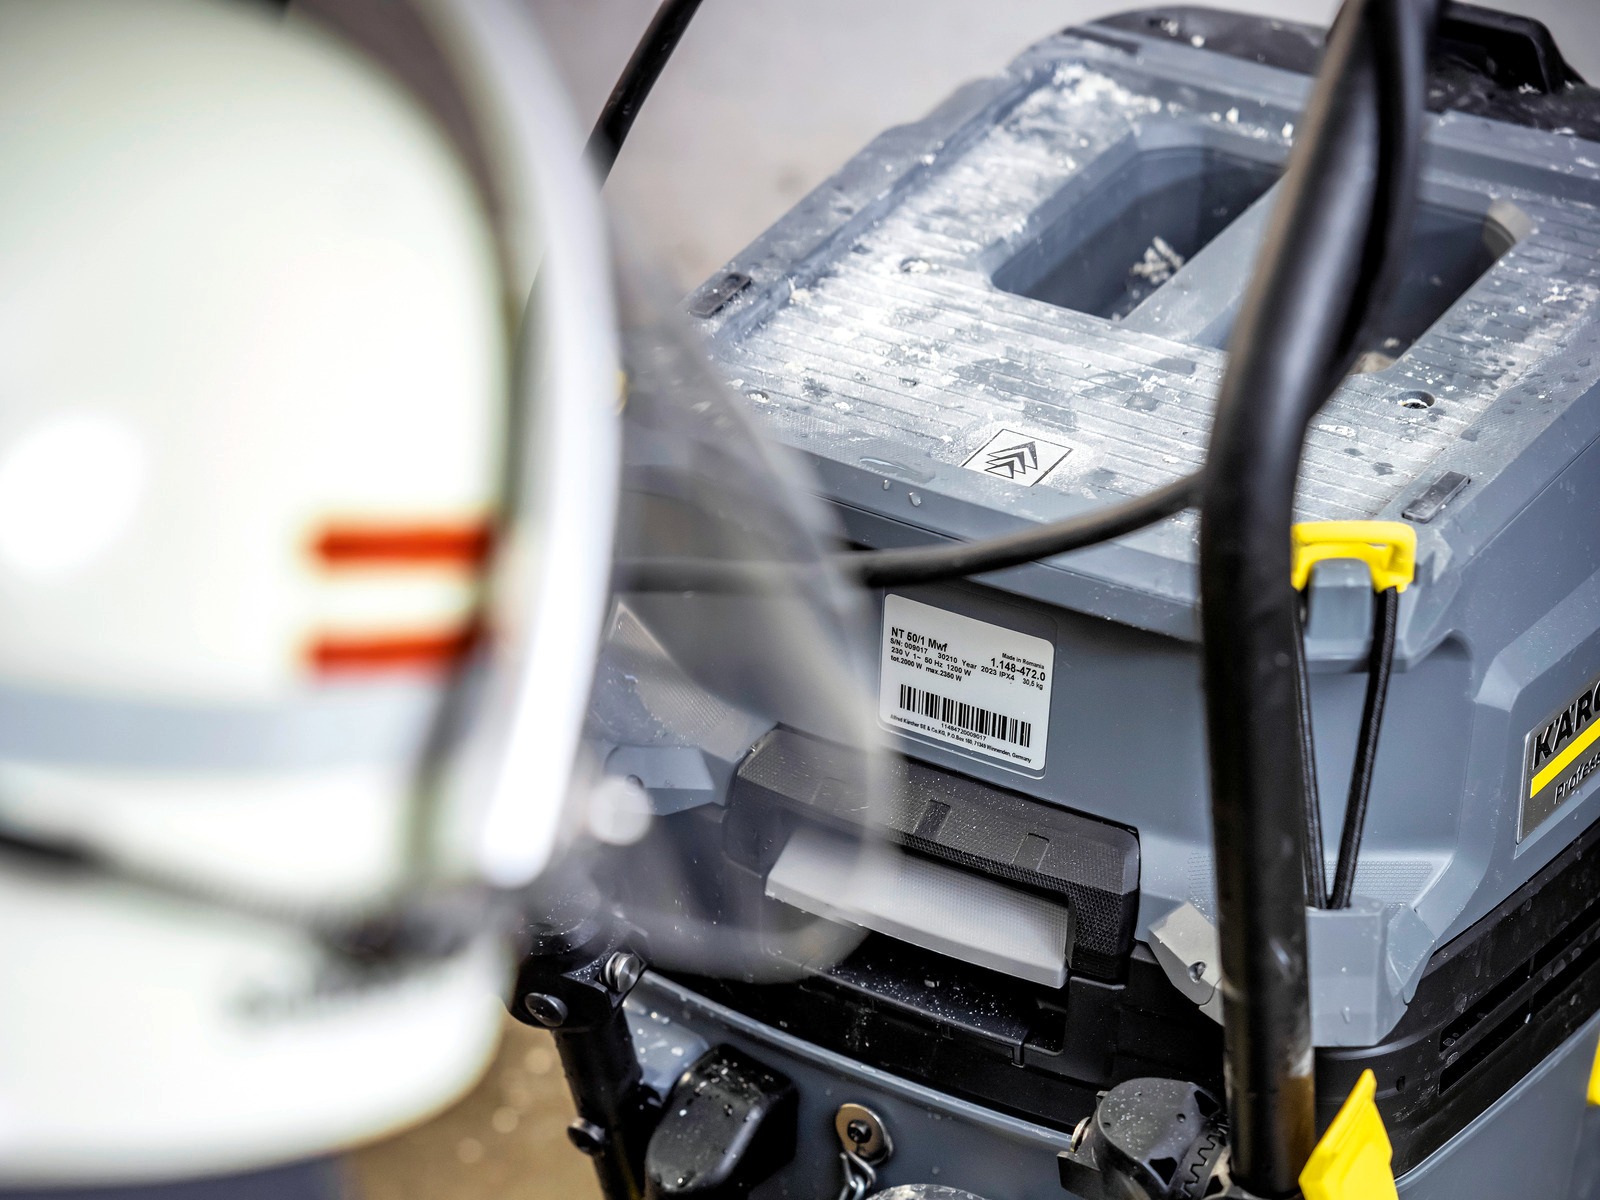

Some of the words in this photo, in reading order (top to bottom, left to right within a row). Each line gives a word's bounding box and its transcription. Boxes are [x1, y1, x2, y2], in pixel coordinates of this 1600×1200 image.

[891, 626, 905, 638] NT
[906, 631, 925, 645] 50/1
[927, 637, 948, 652] Mwf
[889, 637, 903, 646] S/N:
[903, 641, 929, 654] 009017
[937, 652, 958, 663] 30210
[961, 659, 978, 669] Year
[980, 665, 997, 675] 2023
[1035, 681, 1044, 690] kg
[891, 646, 904, 655] 230
[924, 656, 933, 664] 50
[933, 659, 943, 668] Hz
[946, 663, 963, 673] 1200
[963, 668, 972, 676] W
[990, 657, 1046, 681] 1.148-472.0
[1001, 652, 1016, 661] Made
[1022, 658, 1045, 669] Romania
